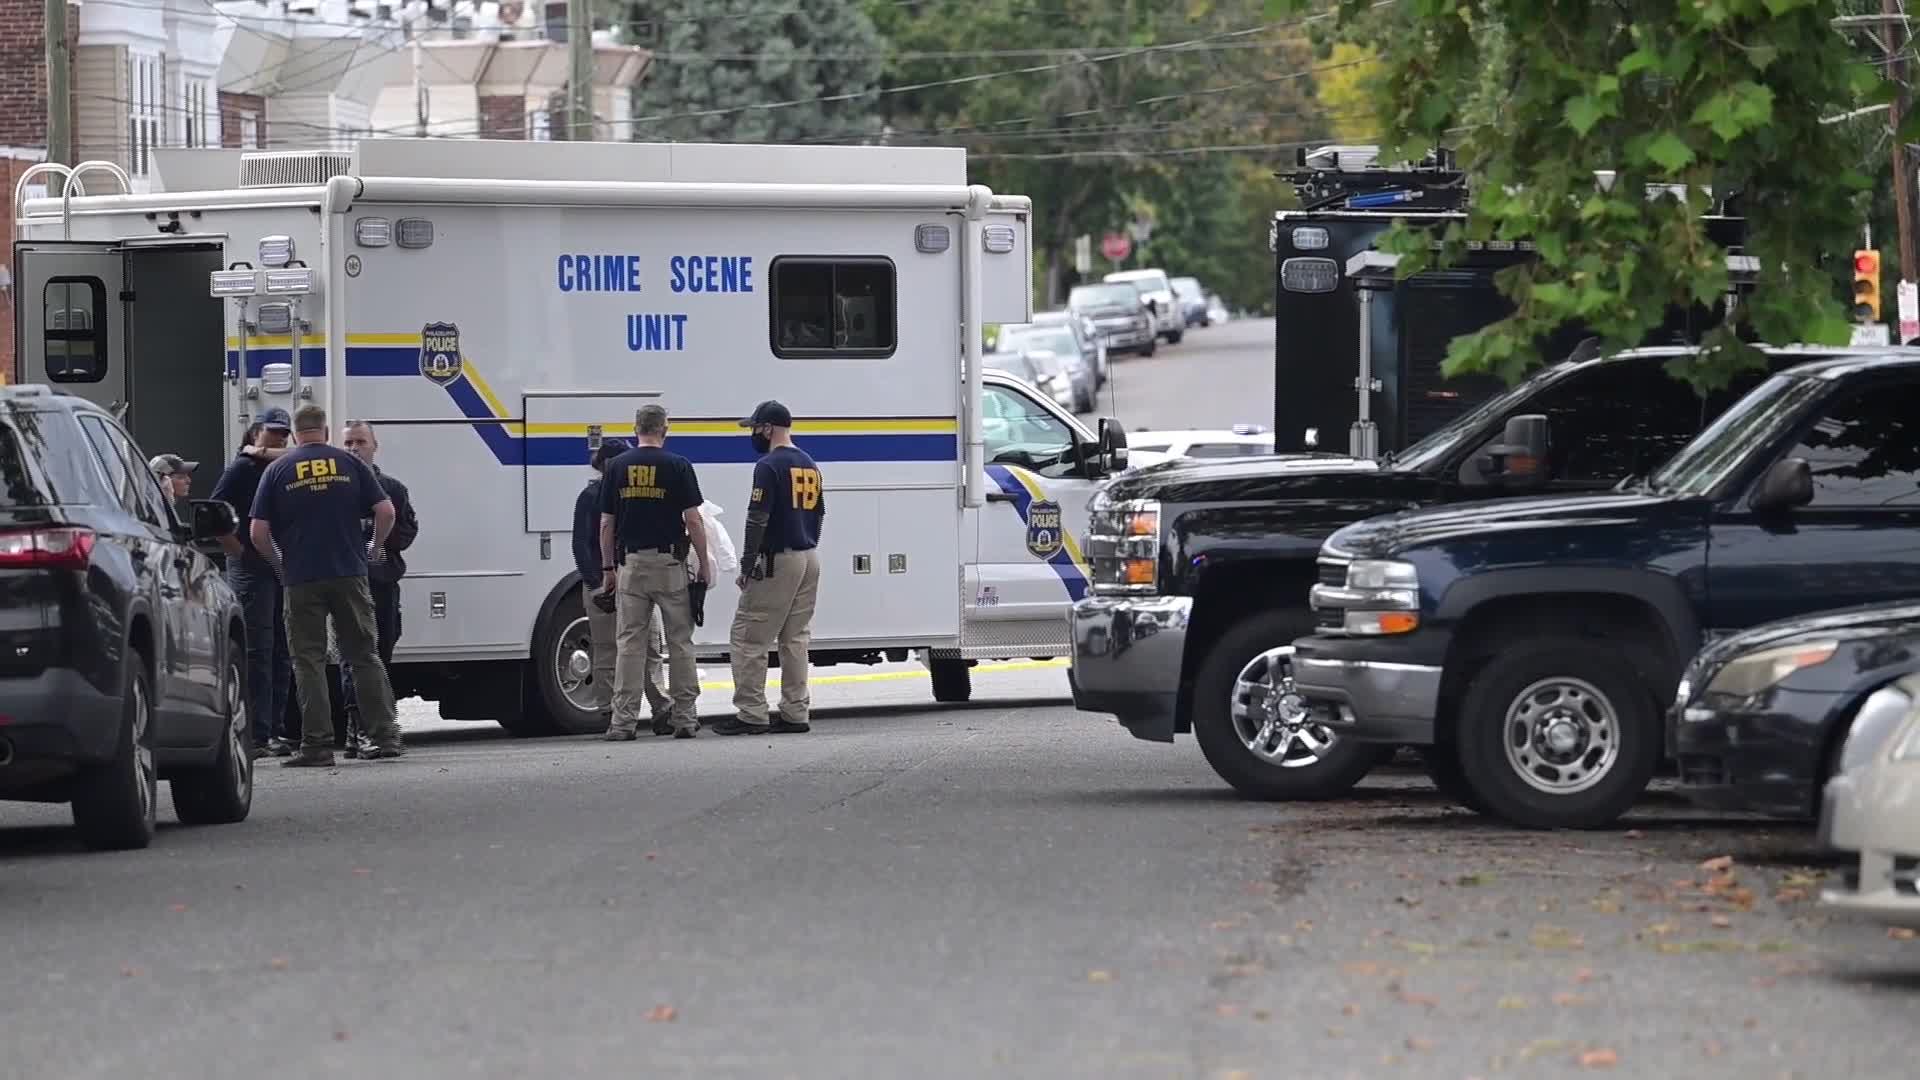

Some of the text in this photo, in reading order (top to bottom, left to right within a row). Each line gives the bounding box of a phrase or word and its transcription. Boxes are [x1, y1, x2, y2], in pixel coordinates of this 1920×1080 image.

[557, 254, 753, 293] CRIME SCENE
[627, 314, 688, 351] UNIT
[426, 336, 456, 352] POLICE
[295, 458, 337, 480] FBI
[627, 464, 656, 487] FBI
[752, 488, 763, 502] BI
[1031, 514, 1058, 528] POLICE
